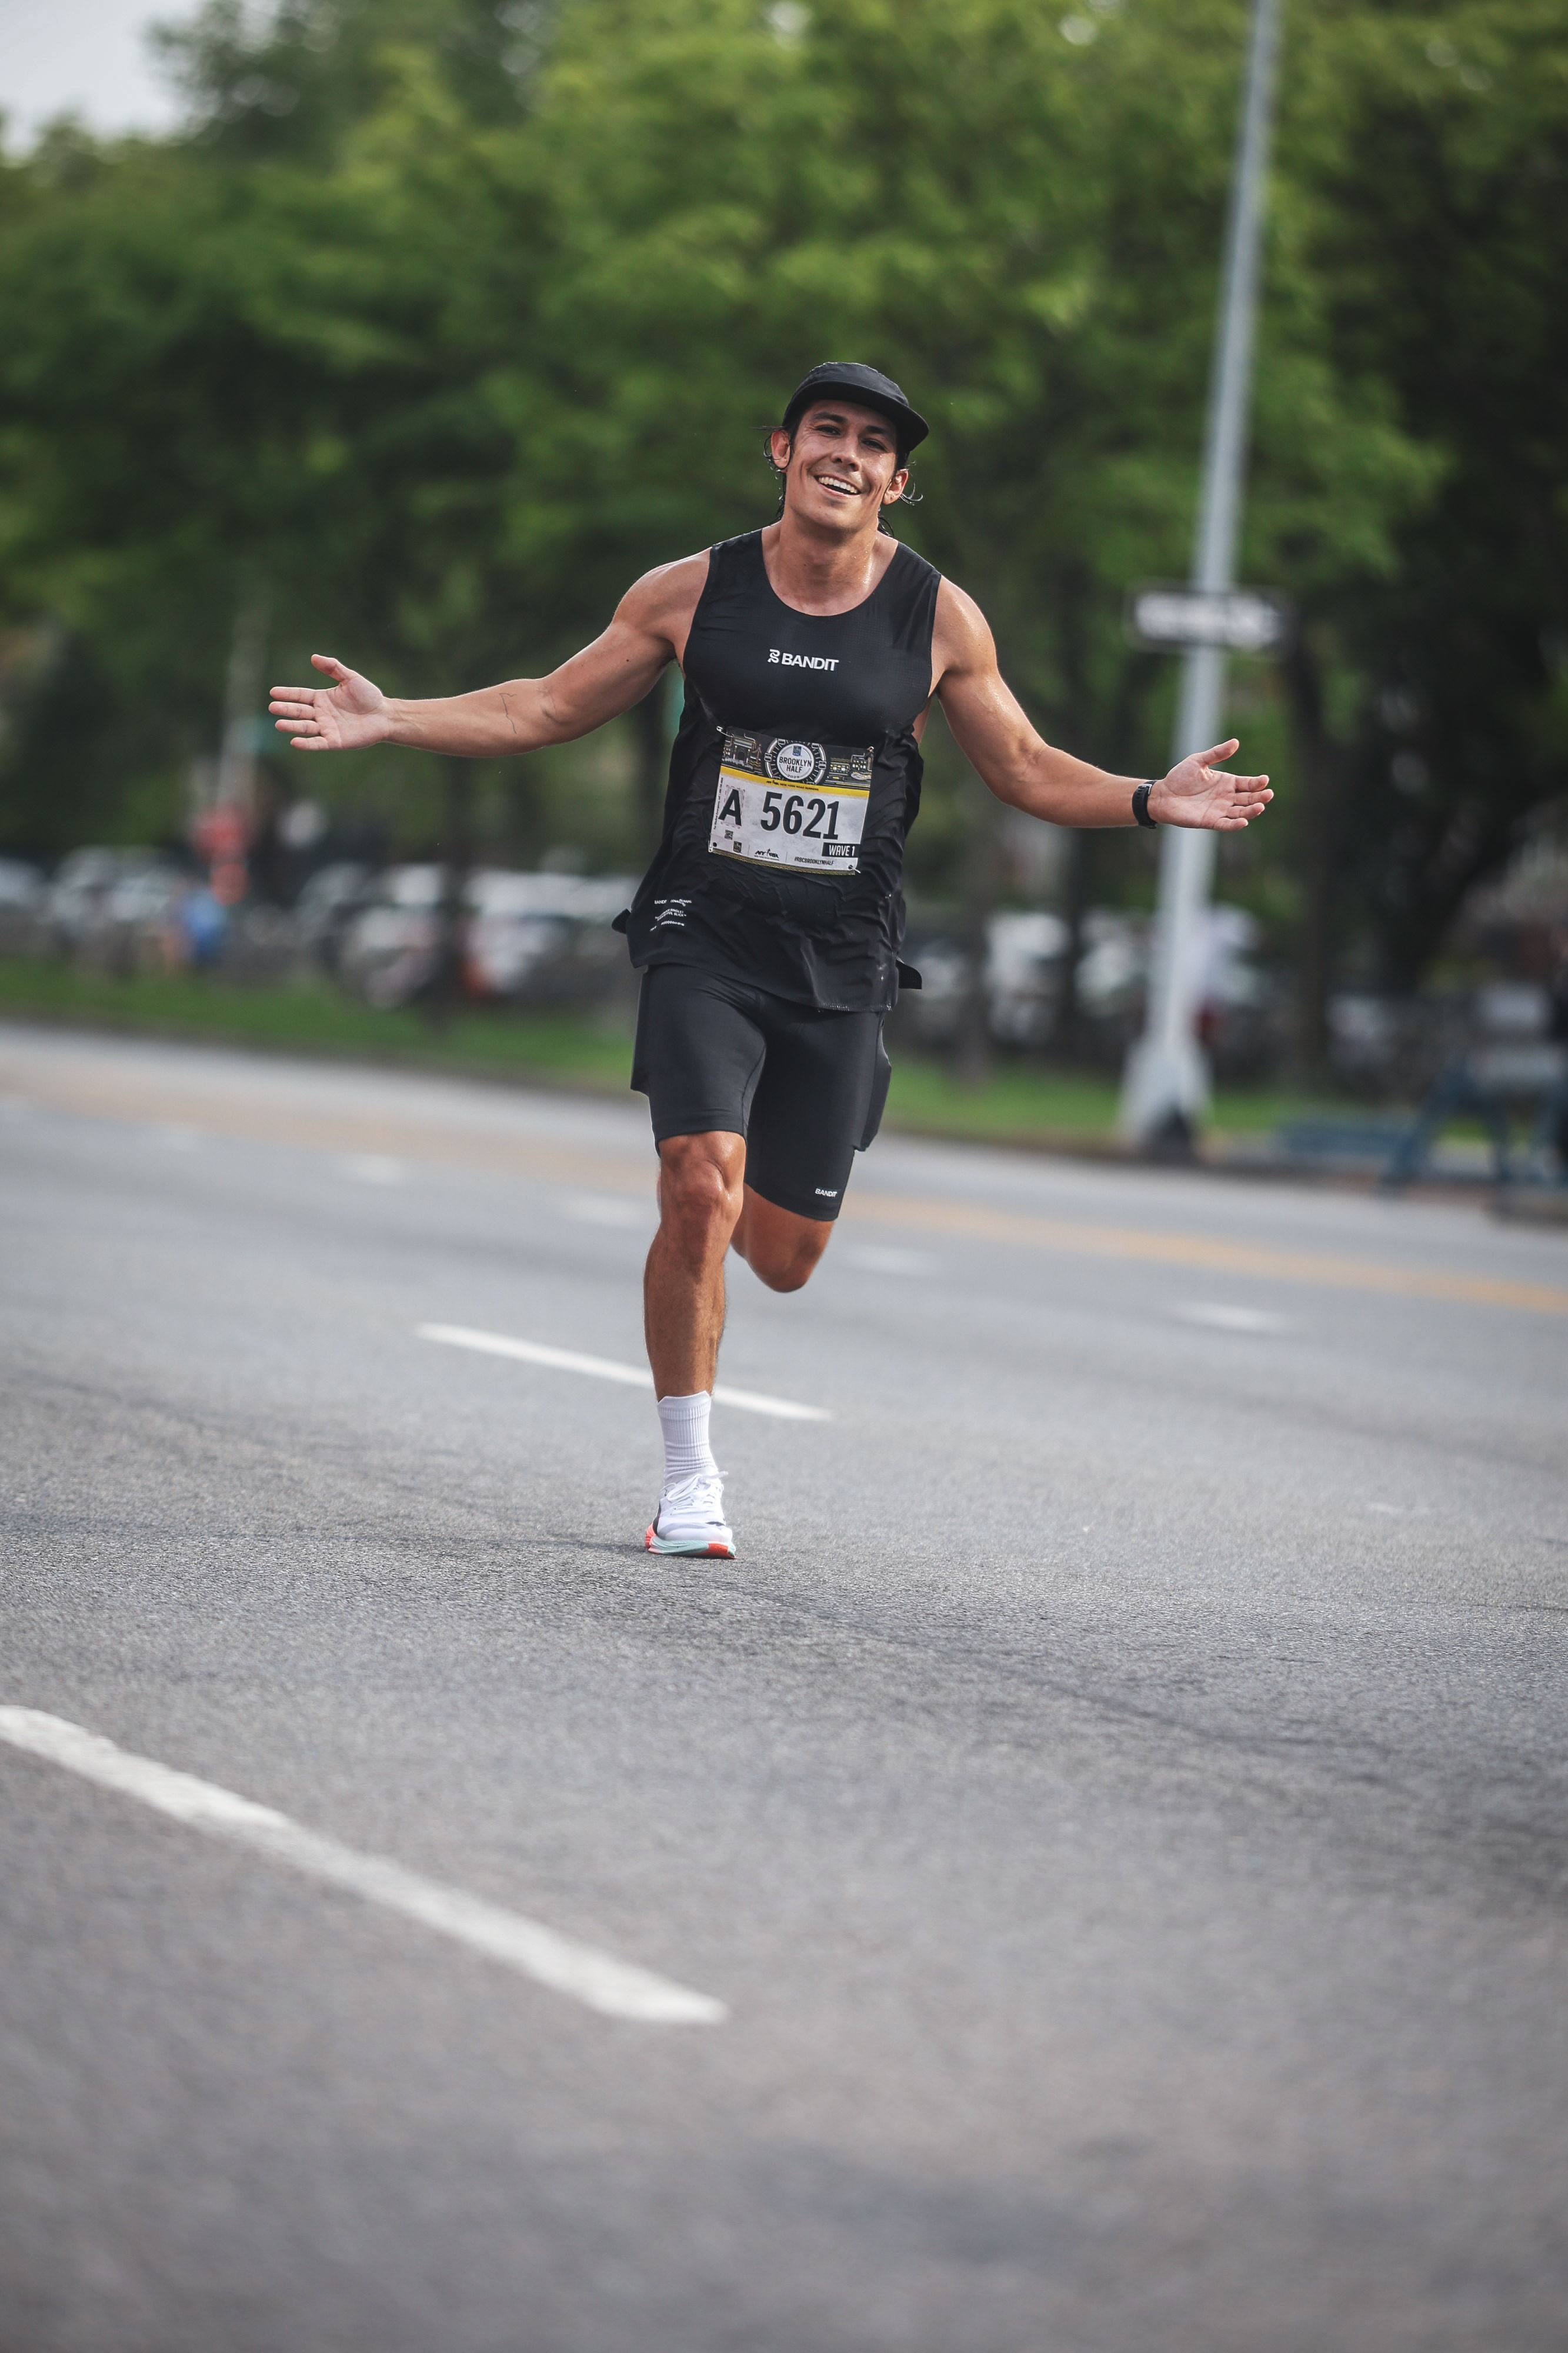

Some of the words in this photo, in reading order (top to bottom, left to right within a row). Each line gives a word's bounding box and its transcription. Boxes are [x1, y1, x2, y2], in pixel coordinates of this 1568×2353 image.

[781, 652, 839, 671] BANDIT
[779, 756, 812, 767] BROOKLYN
[718, 789, 742, 826] A
[760, 791, 839, 840] 5621
[829, 845, 850, 856] WAVE
[852, 845, 855, 856] 1
[794, 856, 835, 866] #RBCBROOKLYNHALF
[815, 1188, 838, 1197] BANDIT
